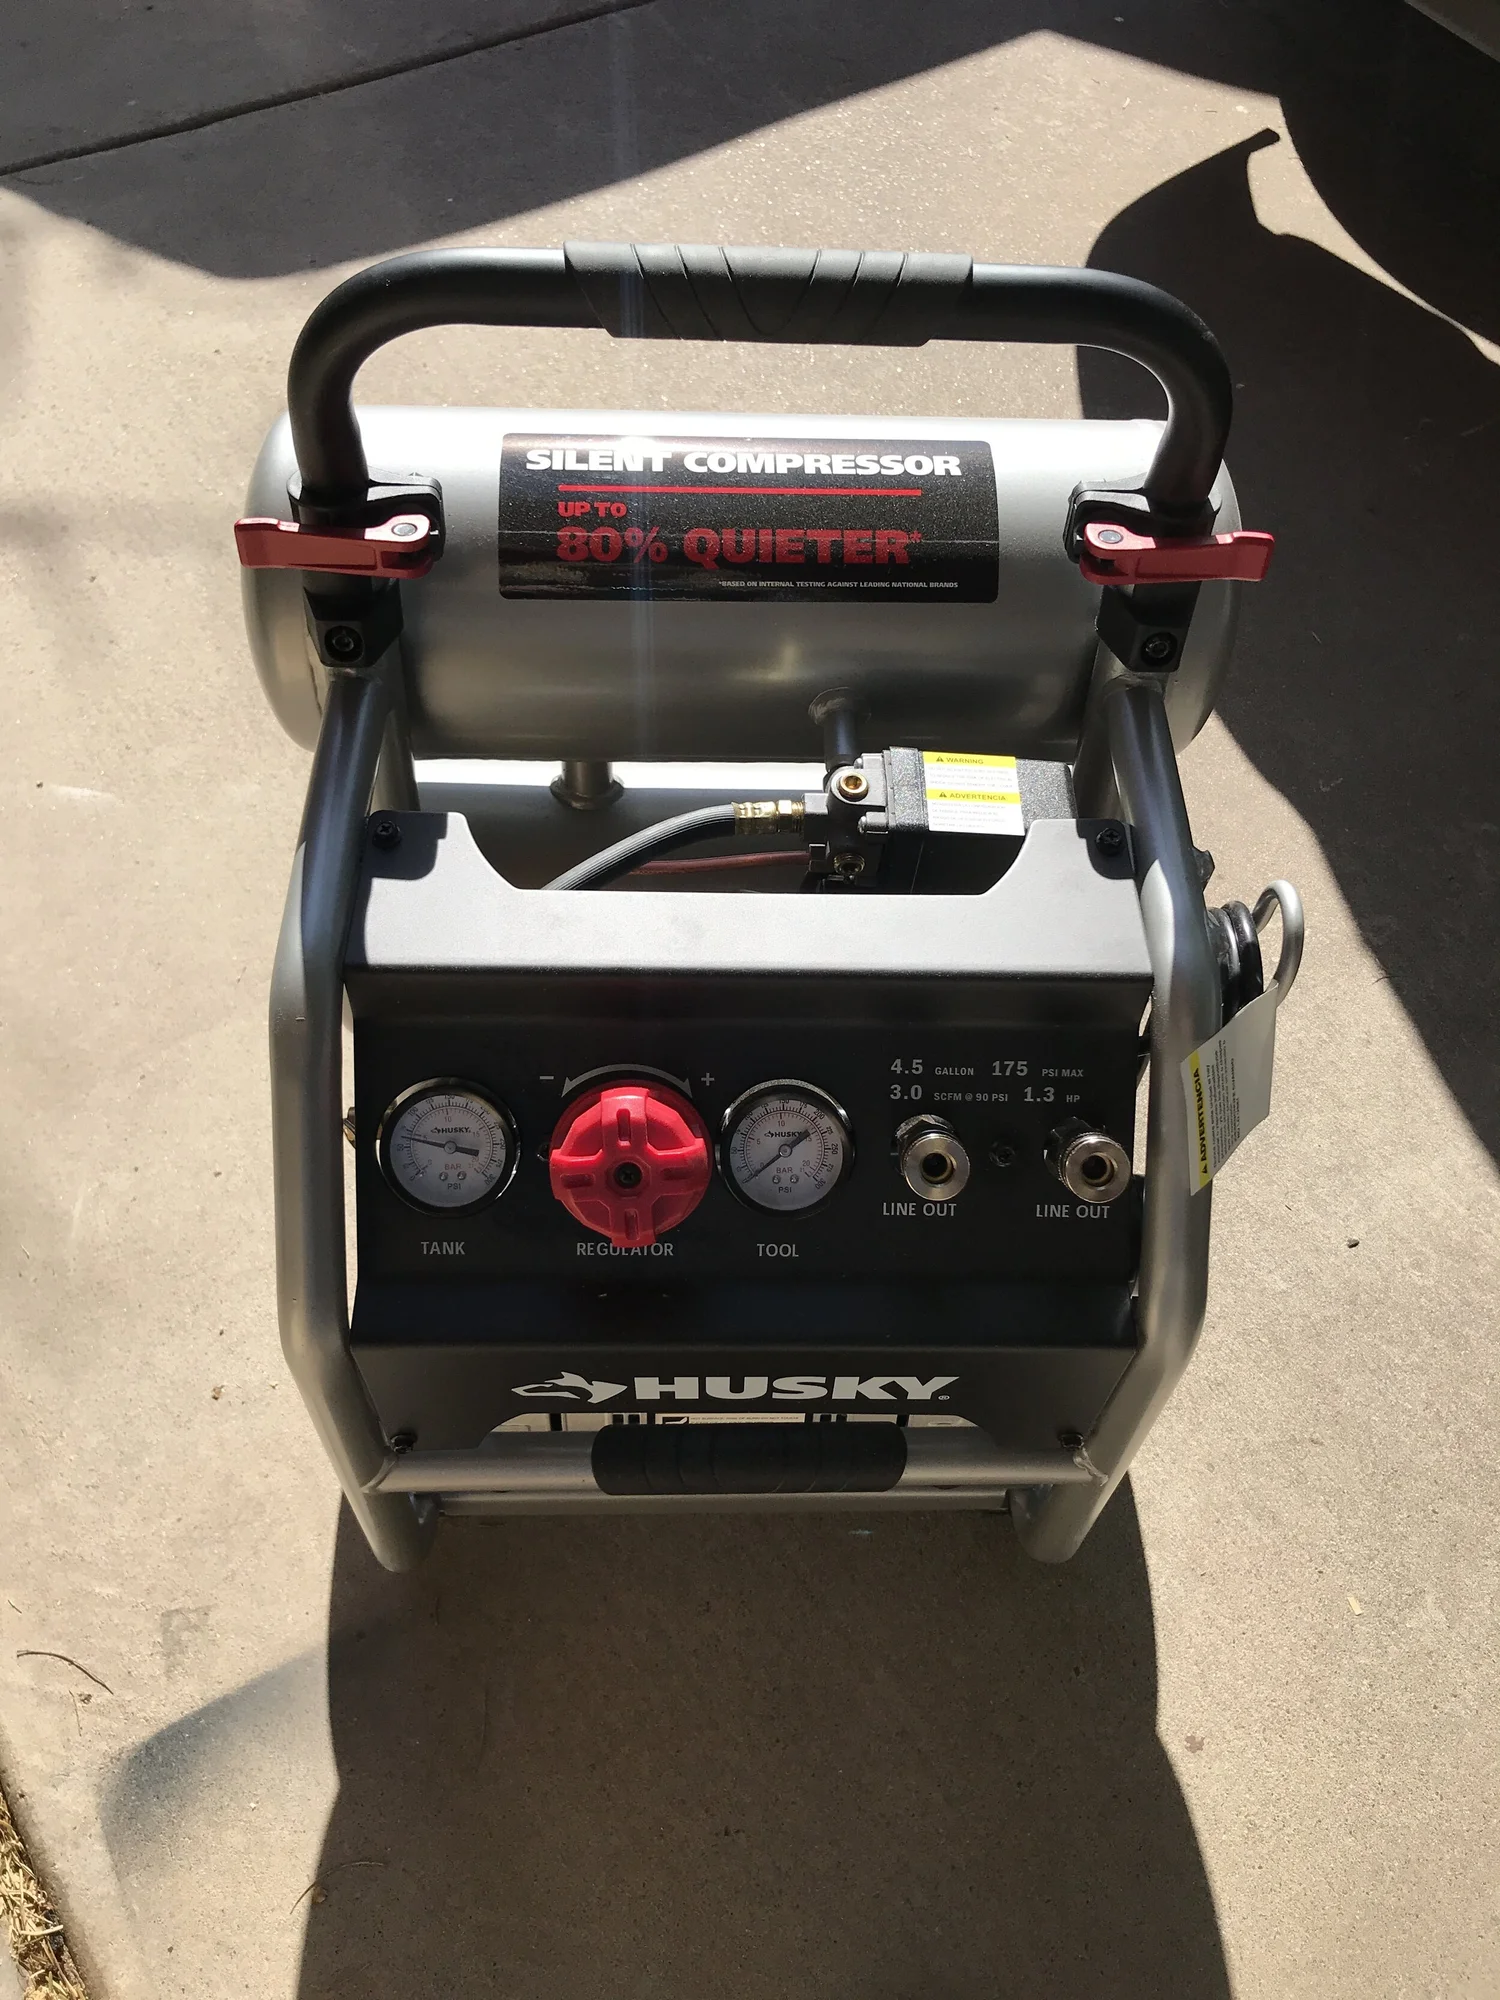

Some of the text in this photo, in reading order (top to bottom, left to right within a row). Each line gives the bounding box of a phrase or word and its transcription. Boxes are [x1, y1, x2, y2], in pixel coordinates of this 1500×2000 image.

[525, 449, 962, 476] SILENT COMPRESSOR
[558, 501, 627, 518] UP TO
[557, 526, 668, 563] 80%
[946, 757, 984, 765] WARNING
[950, 792, 1006, 801] ADVERTENCIA
[890, 1058, 1084, 1077] 4.5 GALLON 175 PSI MAX
[890, 1084, 1080, 1103] 3.0 SCFM @ 90 PSI 1.3 HP
[1193, 1067, 1208, 1162] ADVERTENCIA
[441, 1126, 470, 1134] HUSKY
[882, 1202, 957, 1217] LINE OUT
[1036, 1203, 1110, 1219] LINE OUT
[421, 1241, 466, 1255] TANK
[576, 1242, 674, 1256] REGULATOR
[756, 1243, 799, 1257] TOOL
[634, 1376, 960, 1400] HUSKY
